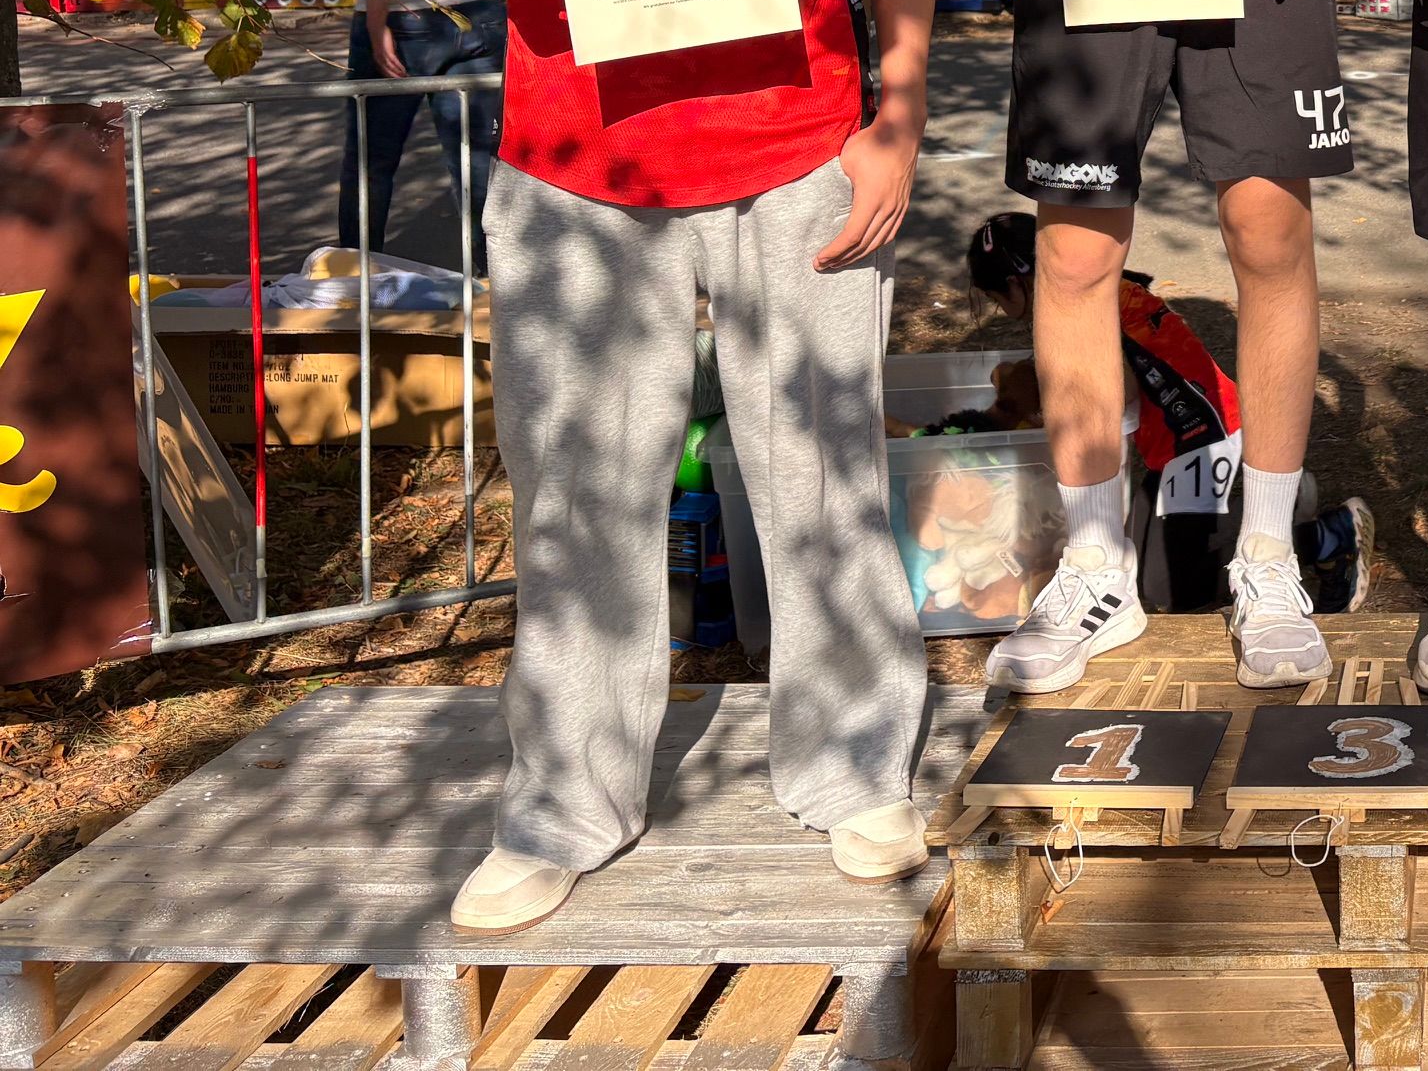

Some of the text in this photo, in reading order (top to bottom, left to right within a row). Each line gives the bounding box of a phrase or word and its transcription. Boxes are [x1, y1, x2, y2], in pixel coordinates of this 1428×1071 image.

[1293, 85, 1346, 132] 47
[1308, 128, 1350, 150] JAKO
[1030, 159, 1120, 185] DRAGONS
[209, 384, 249, 394] HAMBURG
[294, 373, 318, 383] JUMP
[321, 374, 339, 383] MAT
[209, 405, 233, 415] MADE
[236, 405, 246, 415] IN
[1052, 722, 1145, 784] 1
[1308, 715, 1414, 779] 3
